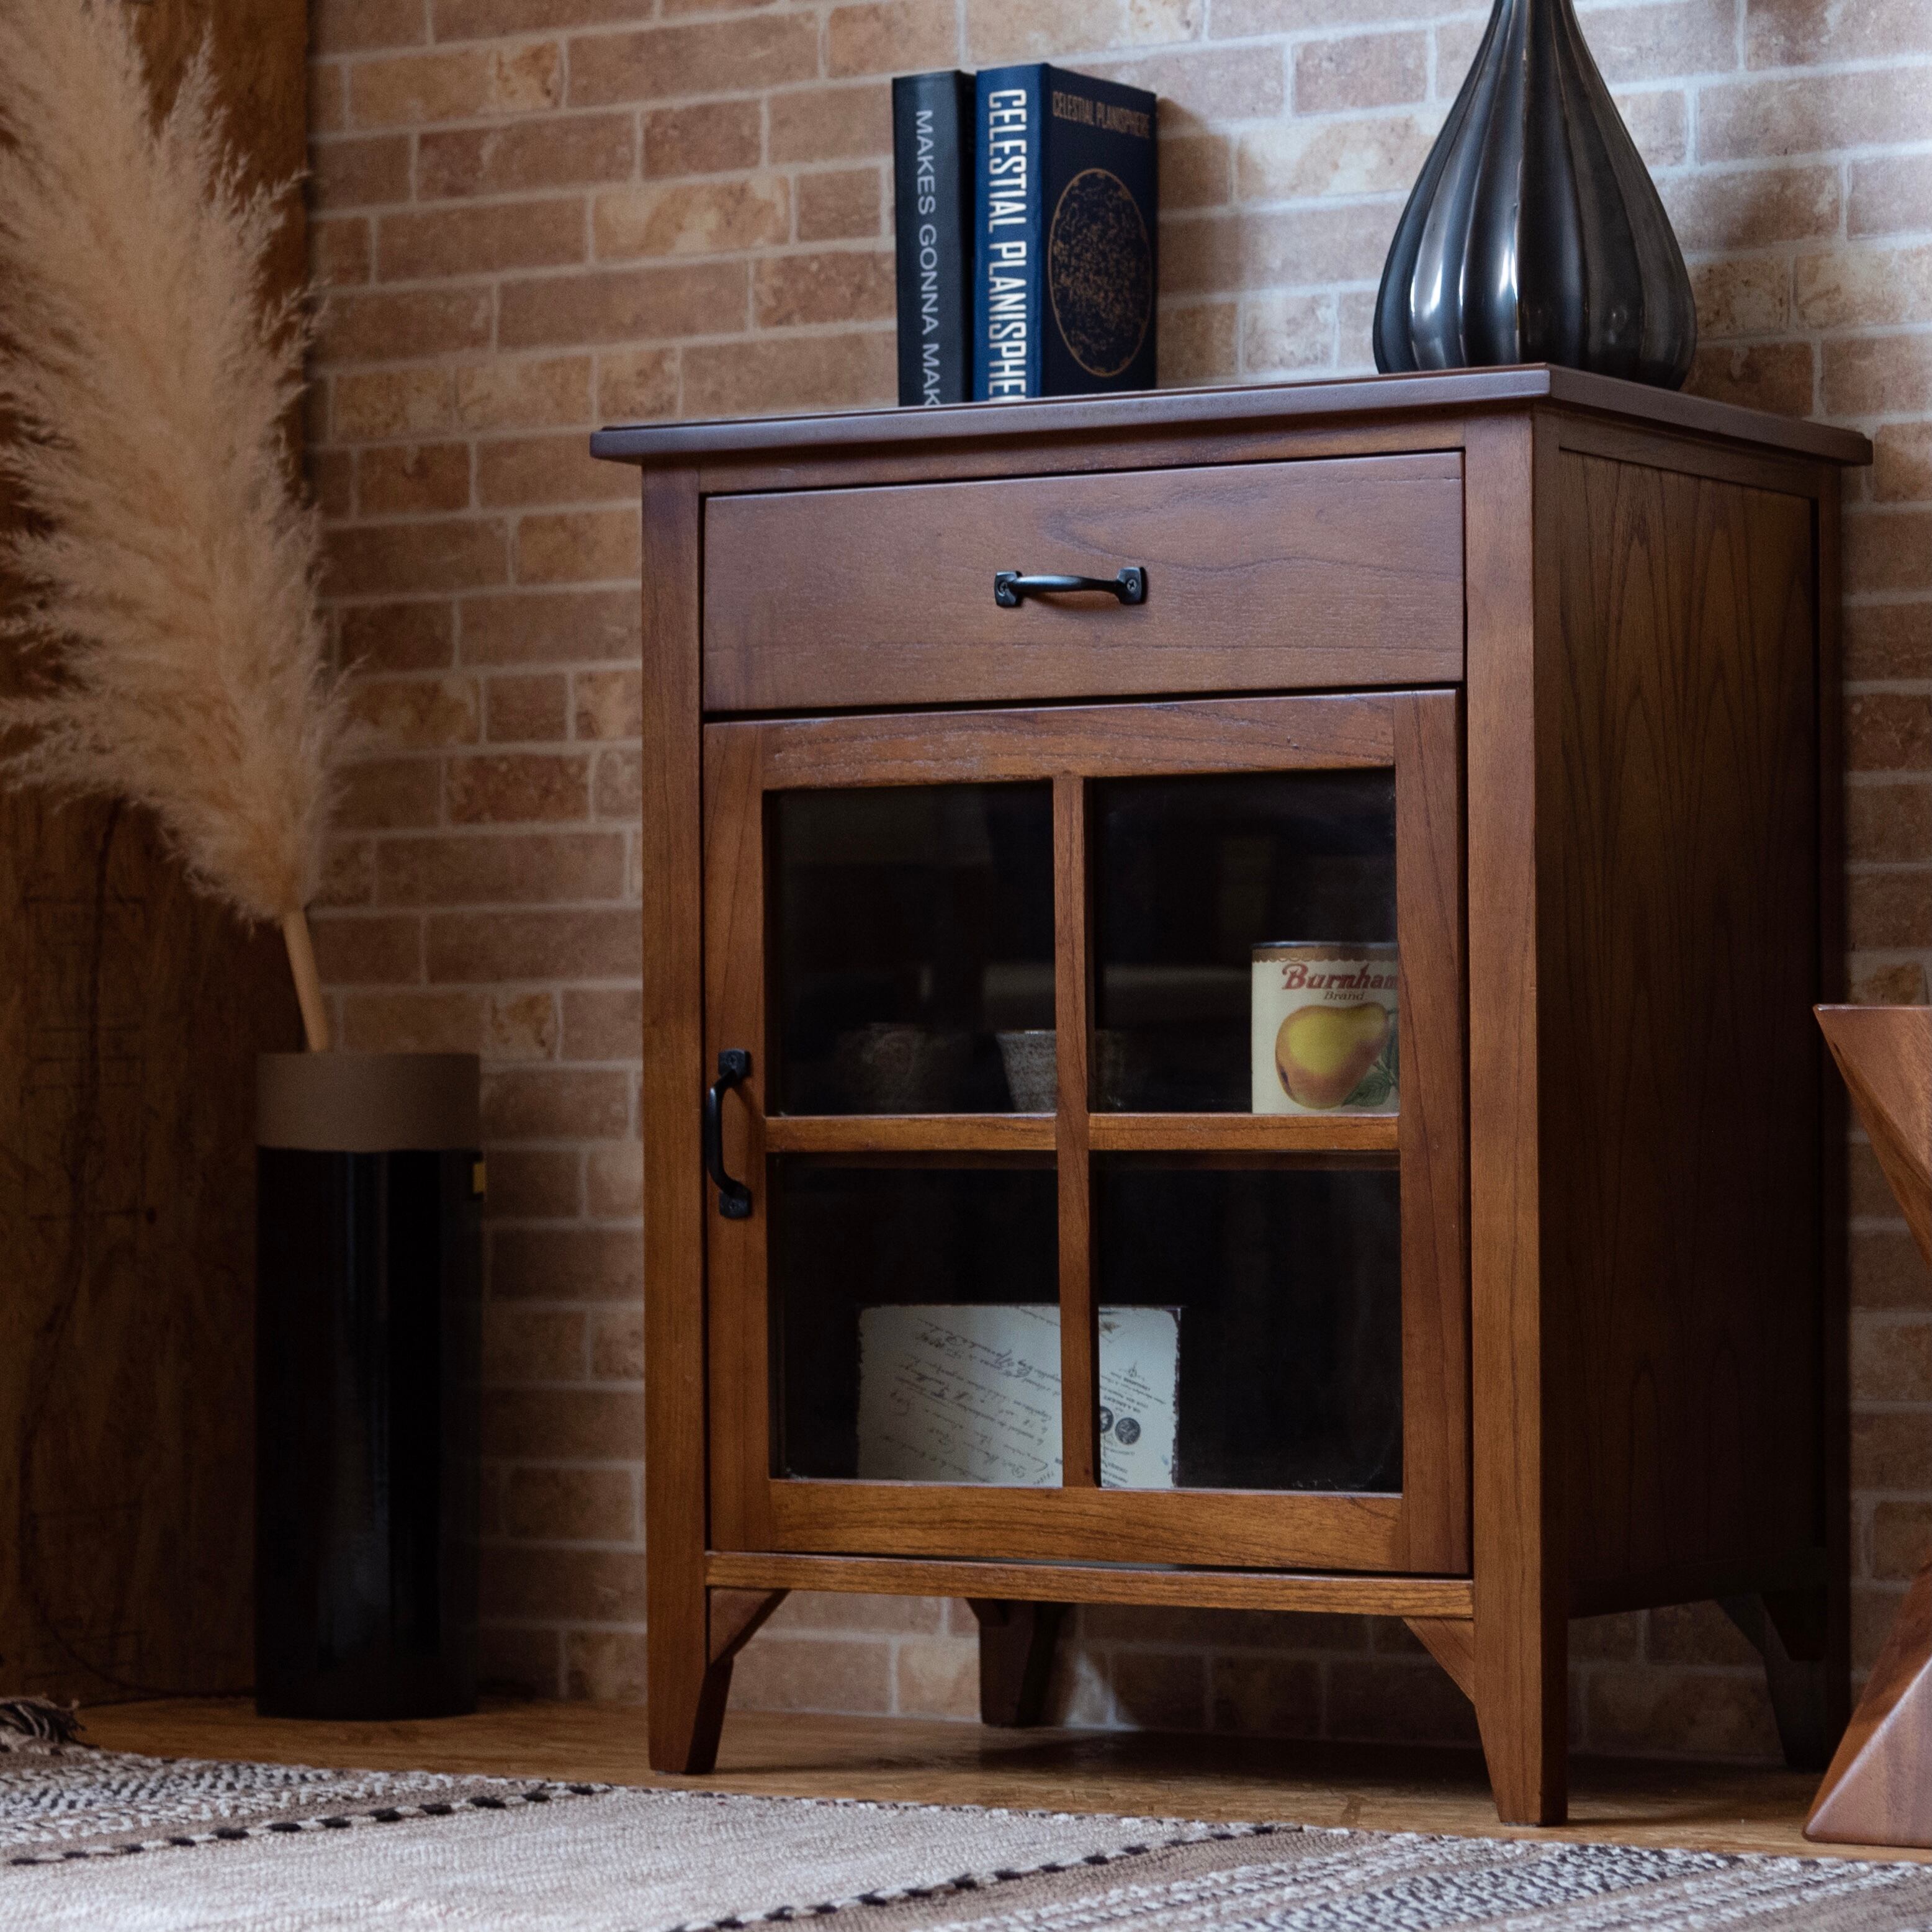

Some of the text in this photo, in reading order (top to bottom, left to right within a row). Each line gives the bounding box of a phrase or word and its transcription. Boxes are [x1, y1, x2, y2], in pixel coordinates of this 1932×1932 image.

[916, 110, 936, 215] MAKES
[989, 89, 1027, 233] CELESTIAL
[919, 224, 939, 335] GONNA
[1324, 992, 1365, 1001] Brand
